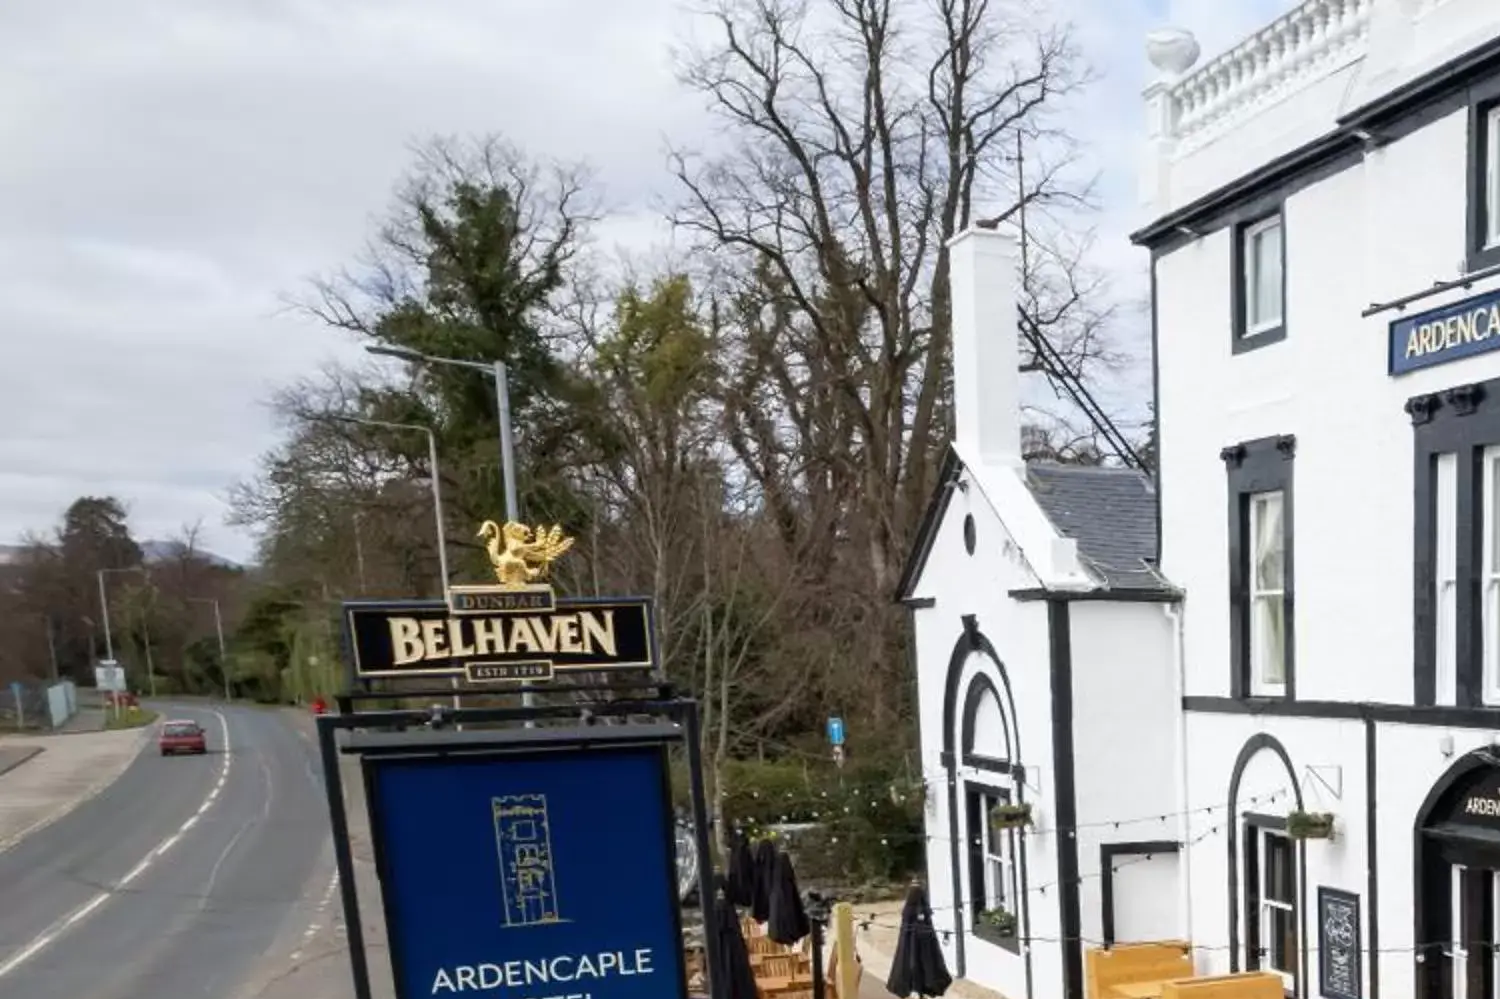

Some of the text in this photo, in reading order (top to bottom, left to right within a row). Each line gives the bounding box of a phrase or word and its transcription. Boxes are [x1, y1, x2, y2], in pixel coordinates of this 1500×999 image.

[462, 594, 544, 609] DUNBAR
[387, 610, 617, 666] BELHAVEN
[431, 948, 655, 995] ARDENCAPLE
